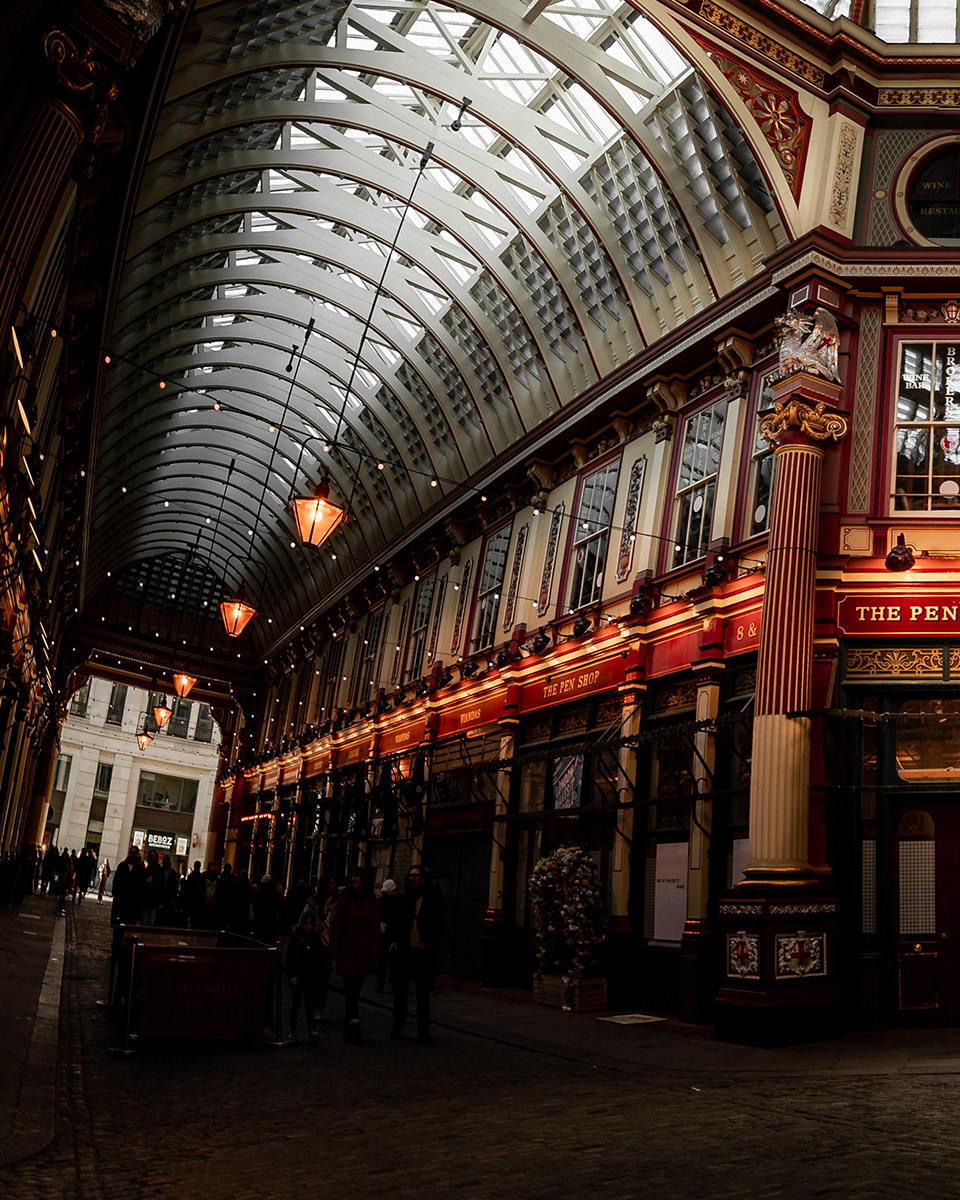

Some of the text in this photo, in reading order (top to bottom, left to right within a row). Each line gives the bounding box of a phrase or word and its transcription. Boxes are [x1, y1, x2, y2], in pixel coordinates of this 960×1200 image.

[922, 181, 953, 189] WINE
[902, 373, 930, 381] WINE
[855, 605, 901, 621] THE
[909, 605, 959, 621] PEN
[736, 622, 757, 641] 8 &
[543, 670, 600, 699] THE PEN SHOP
[147, 833, 173, 846] BEBOZ
